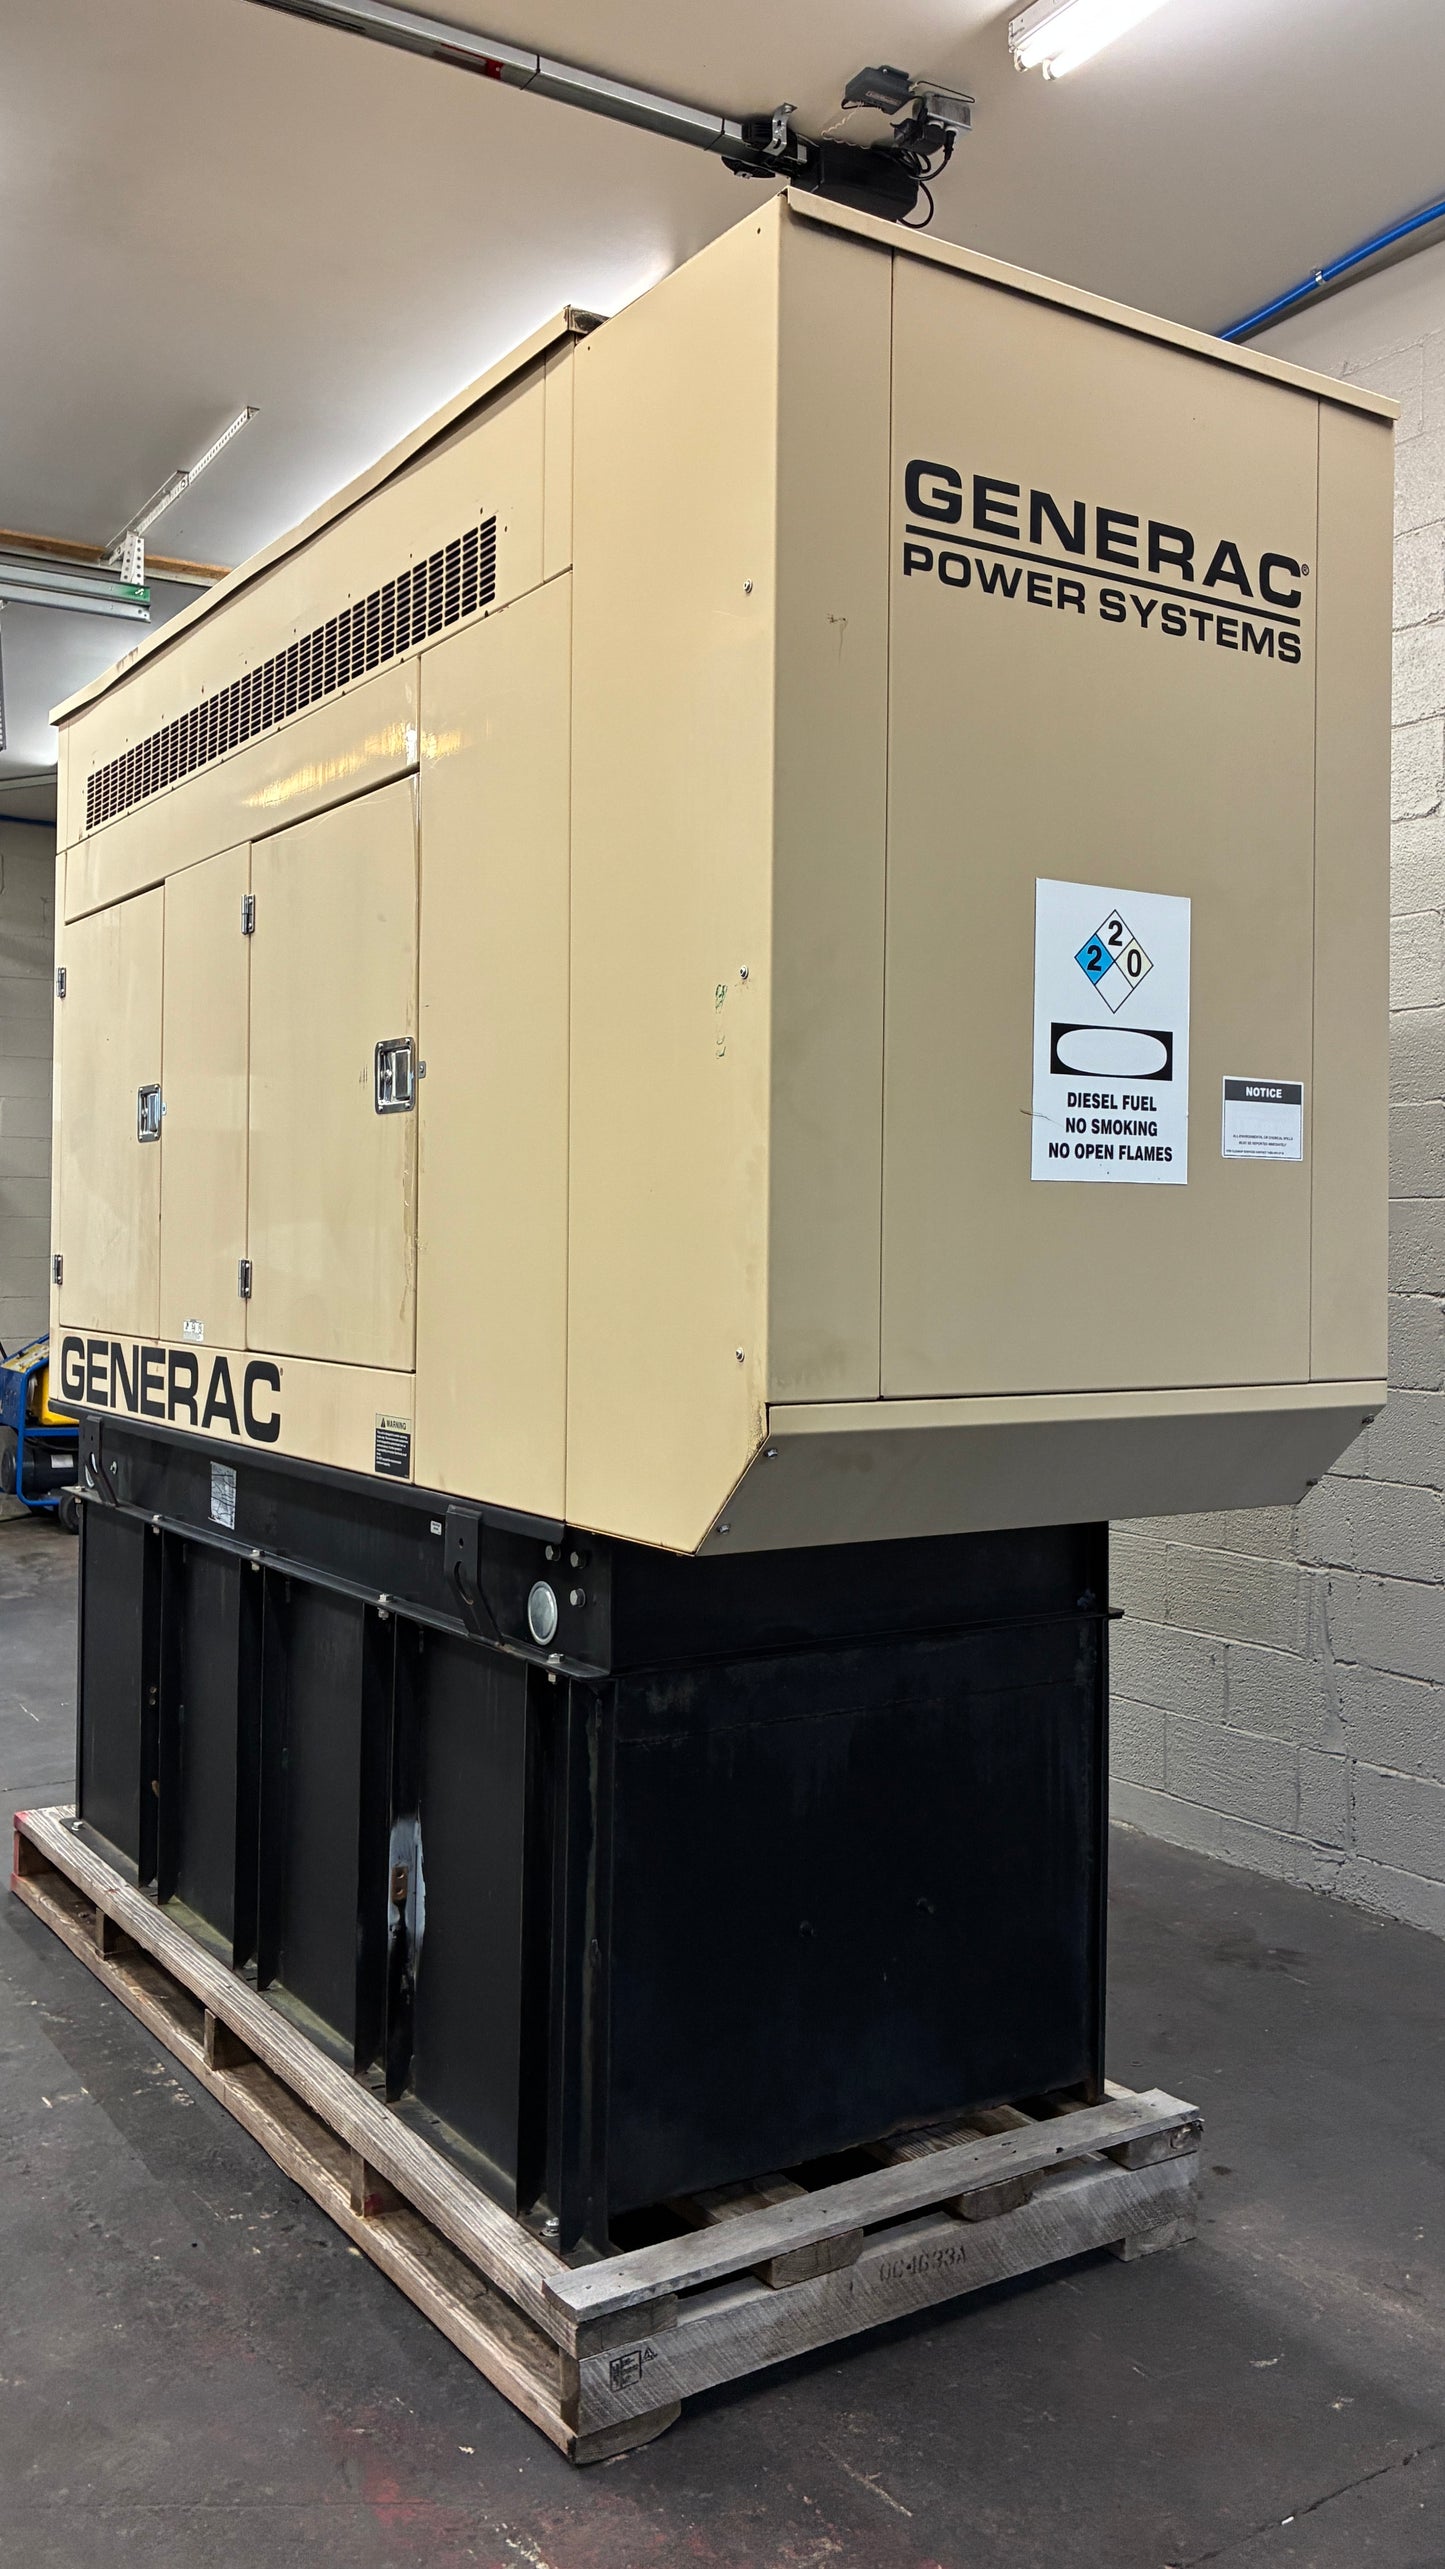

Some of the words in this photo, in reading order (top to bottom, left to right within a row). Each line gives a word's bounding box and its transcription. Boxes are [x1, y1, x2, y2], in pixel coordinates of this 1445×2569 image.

[904, 459, 1302, 609] GENERAC
[903, 541, 1087, 615] POWER
[1099, 588, 1302, 664] SYSTEMS
[1108, 920, 1123, 946] 2
[1086, 944, 1102, 971] 2
[1127, 948, 1142, 978] 0
[1067, 1091, 1119, 1111] DIESEL
[1121, 1094, 1157, 1112] FUEL
[1245, 1086, 1283, 1099] NOTICE
[1065, 1117, 1087, 1134] NO
[1091, 1118, 1158, 1137] SMOKING
[1048, 1142, 1070, 1159] NO
[1074, 1143, 1114, 1160] OPEN
[1118, 1144, 1173, 1162] FLAMES
[61, 1336, 281, 1443] GENERAC
[386, 1419, 407, 1431] WARNING
